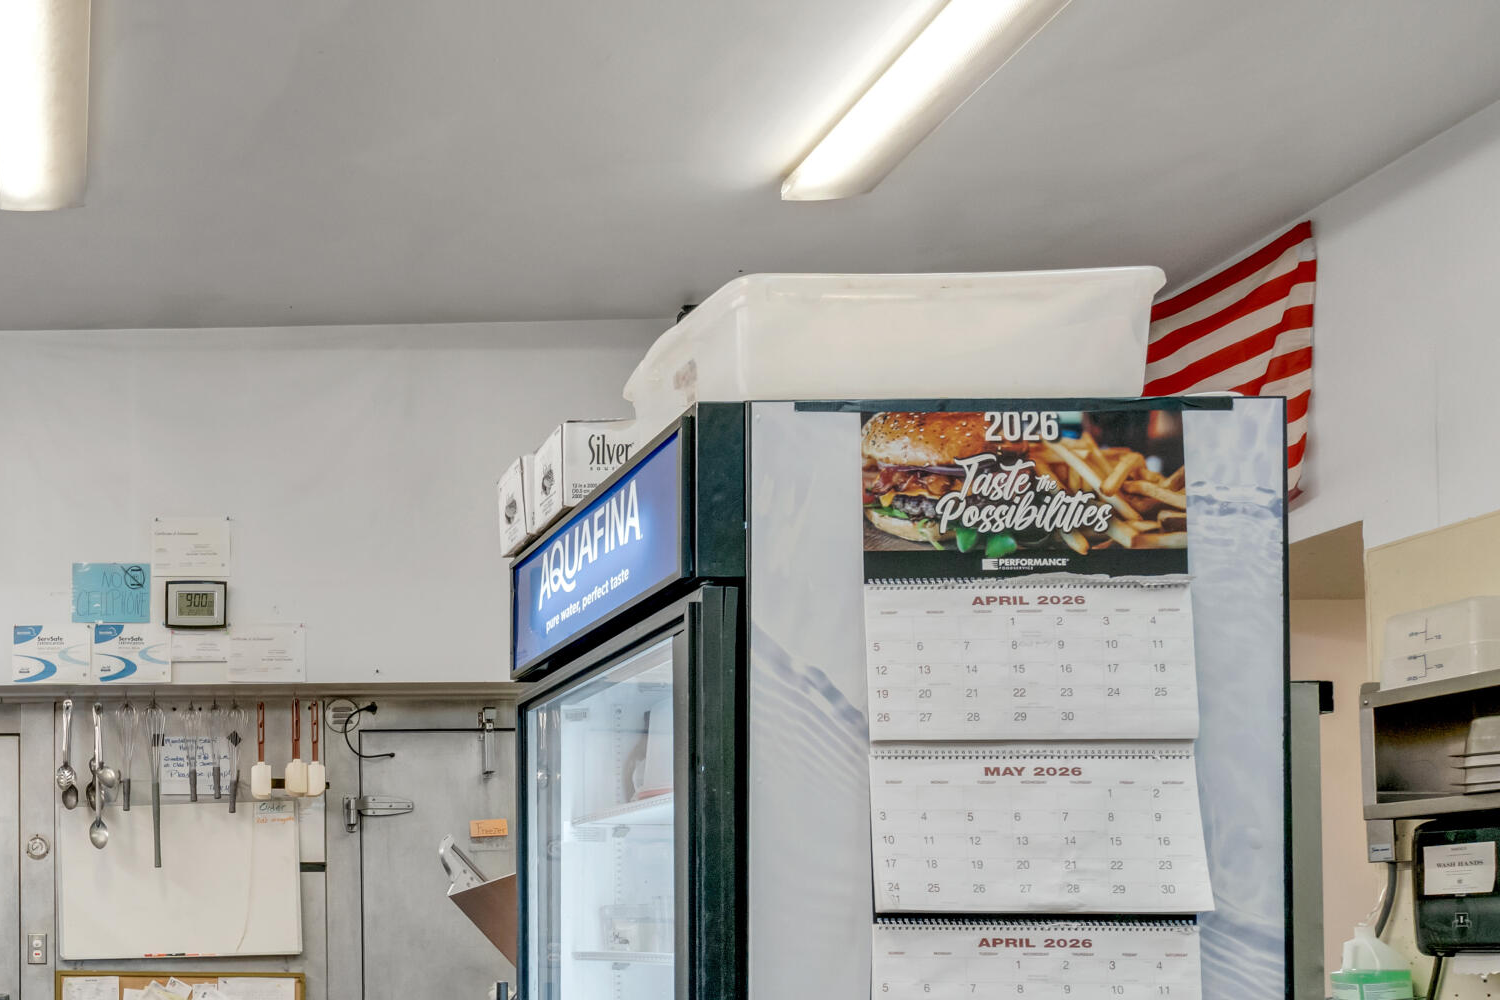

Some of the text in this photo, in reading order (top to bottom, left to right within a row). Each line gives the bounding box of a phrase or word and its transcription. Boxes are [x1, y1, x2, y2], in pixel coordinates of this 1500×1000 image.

[984, 411, 1060, 442] 2026
[588, 434, 632, 465] Silver
[954, 454, 1058, 500] Taste the
[935, 489, 1112, 534] Possibilities
[538, 479, 642, 611] AQUAFINA
[998, 558, 1067, 566] PERFORMANCE
[101, 571, 122, 588] NO
[76, 589, 148, 617] CELLPHONE
[546, 568, 629, 635] pure water, perfect taste
[972, 594, 1086, 606] APRIL 2026
[1010, 616, 1156, 625] 1 2 3 4
[873, 640, 1163, 652] 5 6 7 8 9 10 11
[876, 664, 1166, 675] 12 13 14 15 16 17 18
[877, 687, 1167, 698] 19 20 21 22 23 24 25
[877, 712, 1074, 722] 26 27 28 29 30
[984, 766, 1082, 776] MAY 2026
[1108, 788, 1160, 798] 1 2
[880, 811, 1161, 821] 3 4 5 6 7 8 9
[883, 835, 1170, 846] 10 11 12 13 14 15 16
[886, 858, 1172, 870] 17 18 19 20 21 22 23
[888, 883, 900, 892] 24
[928, 883, 940, 892] 25
[973, 884, 986, 893] 26
[1066, 883, 1080, 893] 28
[1112, 885, 1125, 894] 29
[1161, 885, 1175, 894] 30
[978, 938, 1093, 948] APRIL 2026
[1016, 960, 1162, 970] 1 2 3 4
[882, 983, 1169, 995] 5 6 7 8 9 10 11
